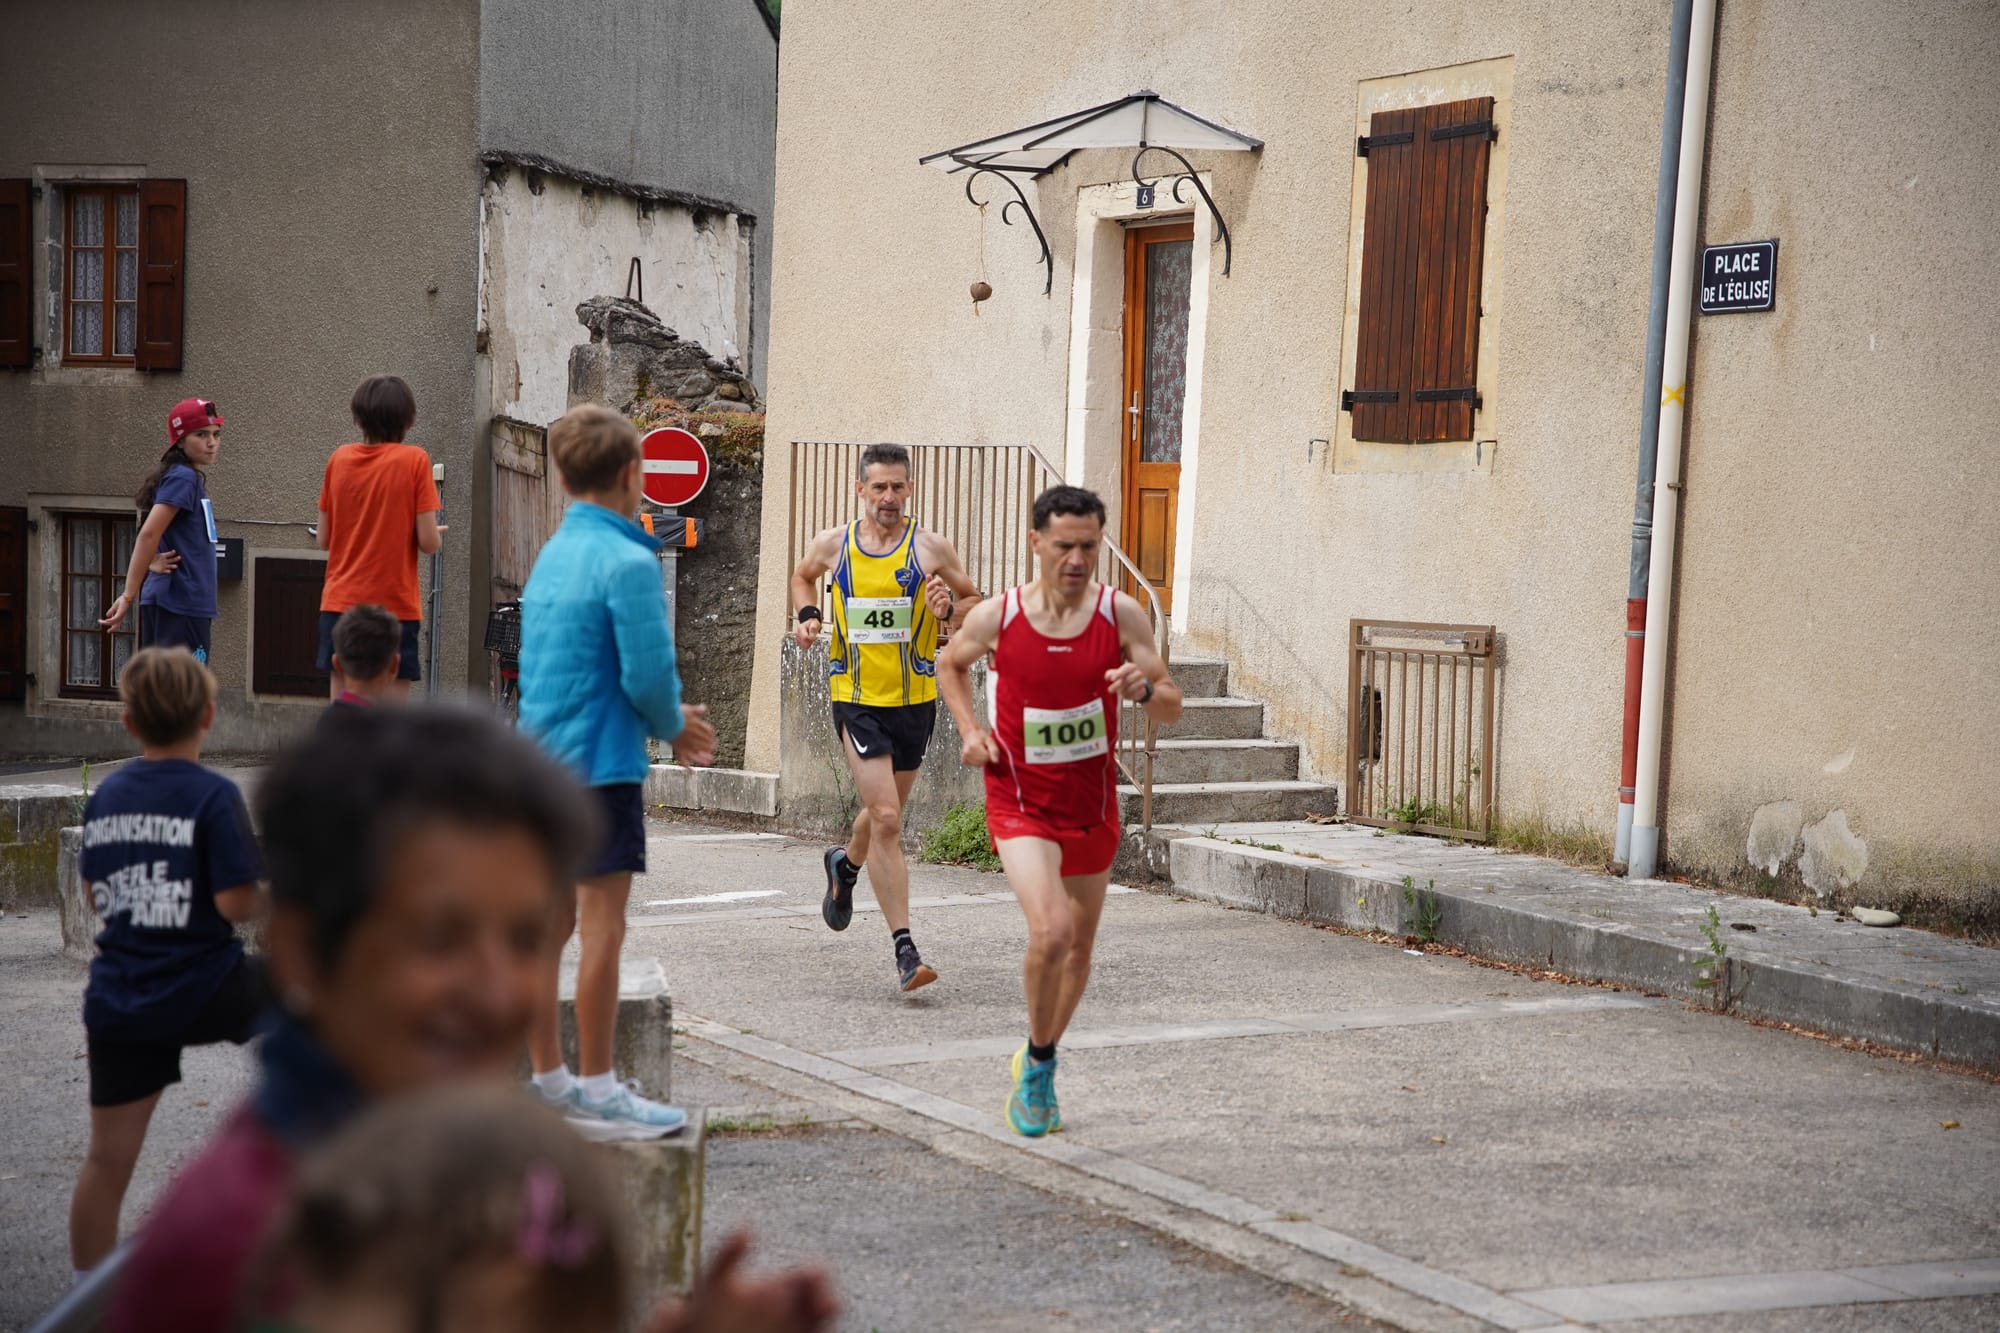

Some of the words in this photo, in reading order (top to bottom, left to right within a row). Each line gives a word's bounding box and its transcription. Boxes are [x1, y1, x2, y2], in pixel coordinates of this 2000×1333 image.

[1142, 189, 1148, 204] 6
[1715, 252, 1760, 274] PLACE
[1703, 286, 1716, 303] DE
[1718, 278, 1769, 302] L'ÉGLISE
[863, 609, 895, 629] 48
[1037, 719, 1095, 745] 100
[84, 814, 196, 848] ORGANISATION
